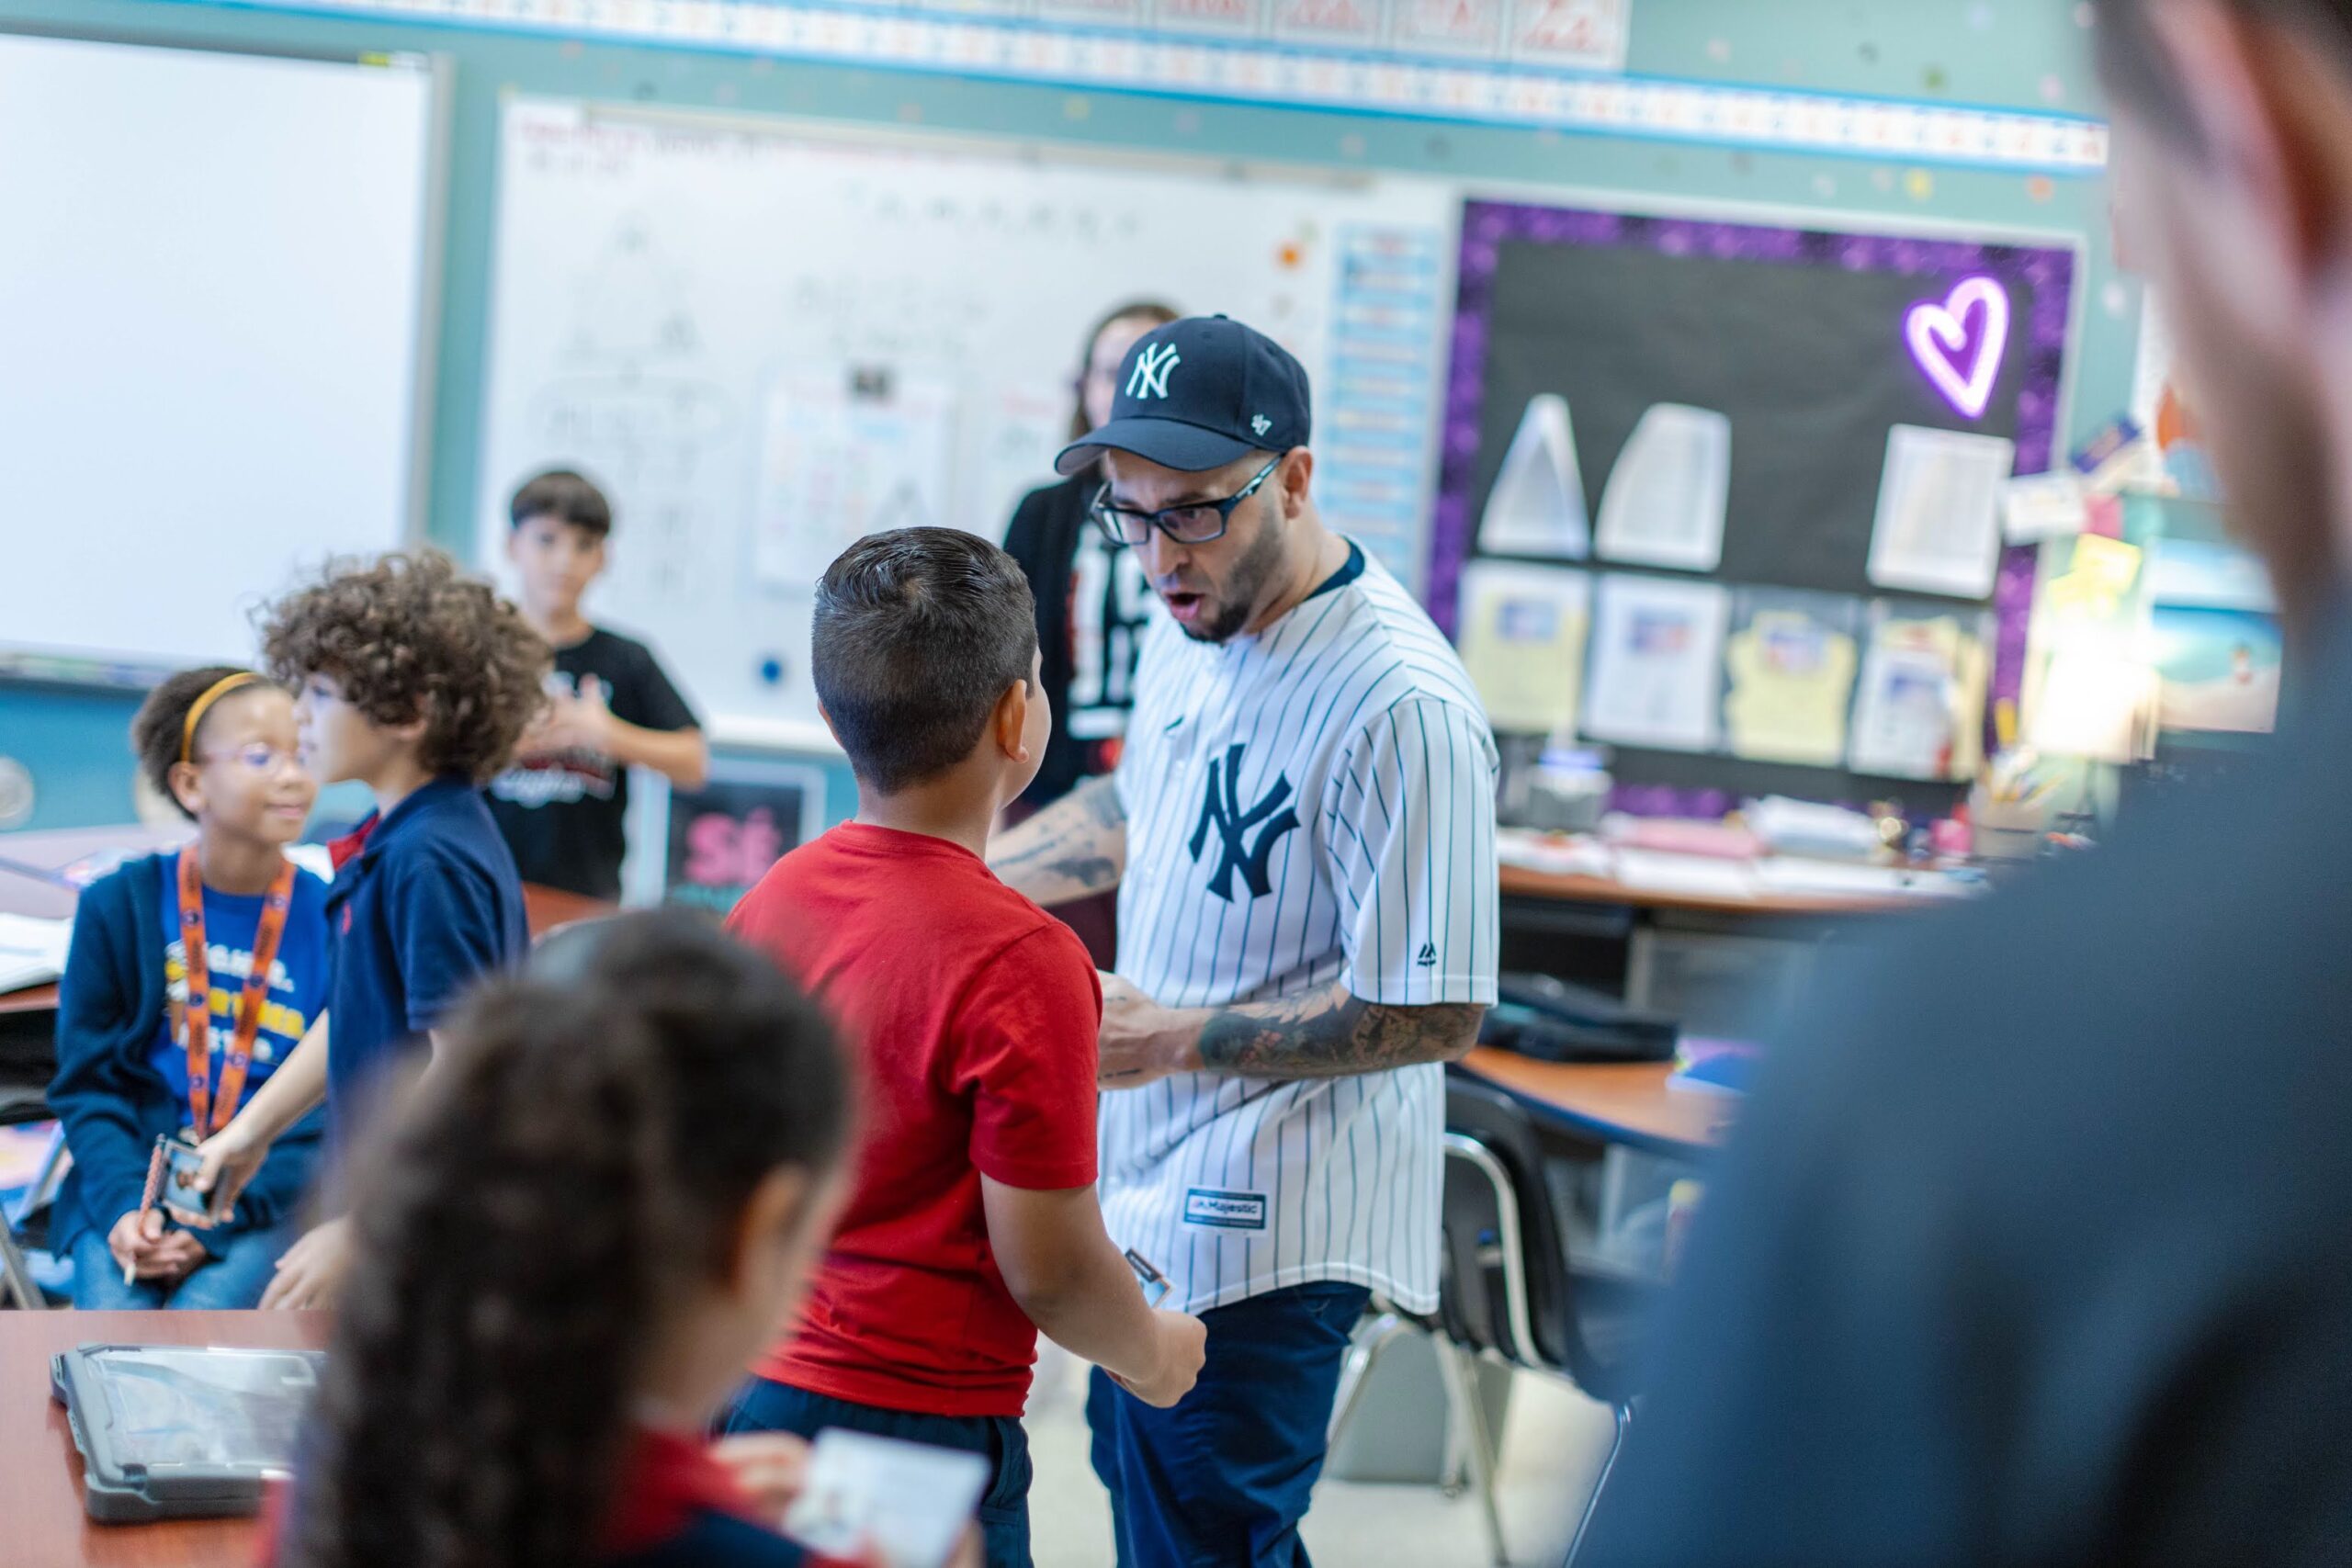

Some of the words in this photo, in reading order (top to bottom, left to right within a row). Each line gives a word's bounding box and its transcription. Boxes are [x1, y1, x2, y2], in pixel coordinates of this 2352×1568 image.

[1125, 342, 1181, 400] NY
[1189, 743, 1301, 903] NY
[1208, 1199, 1258, 1214] Majestic
